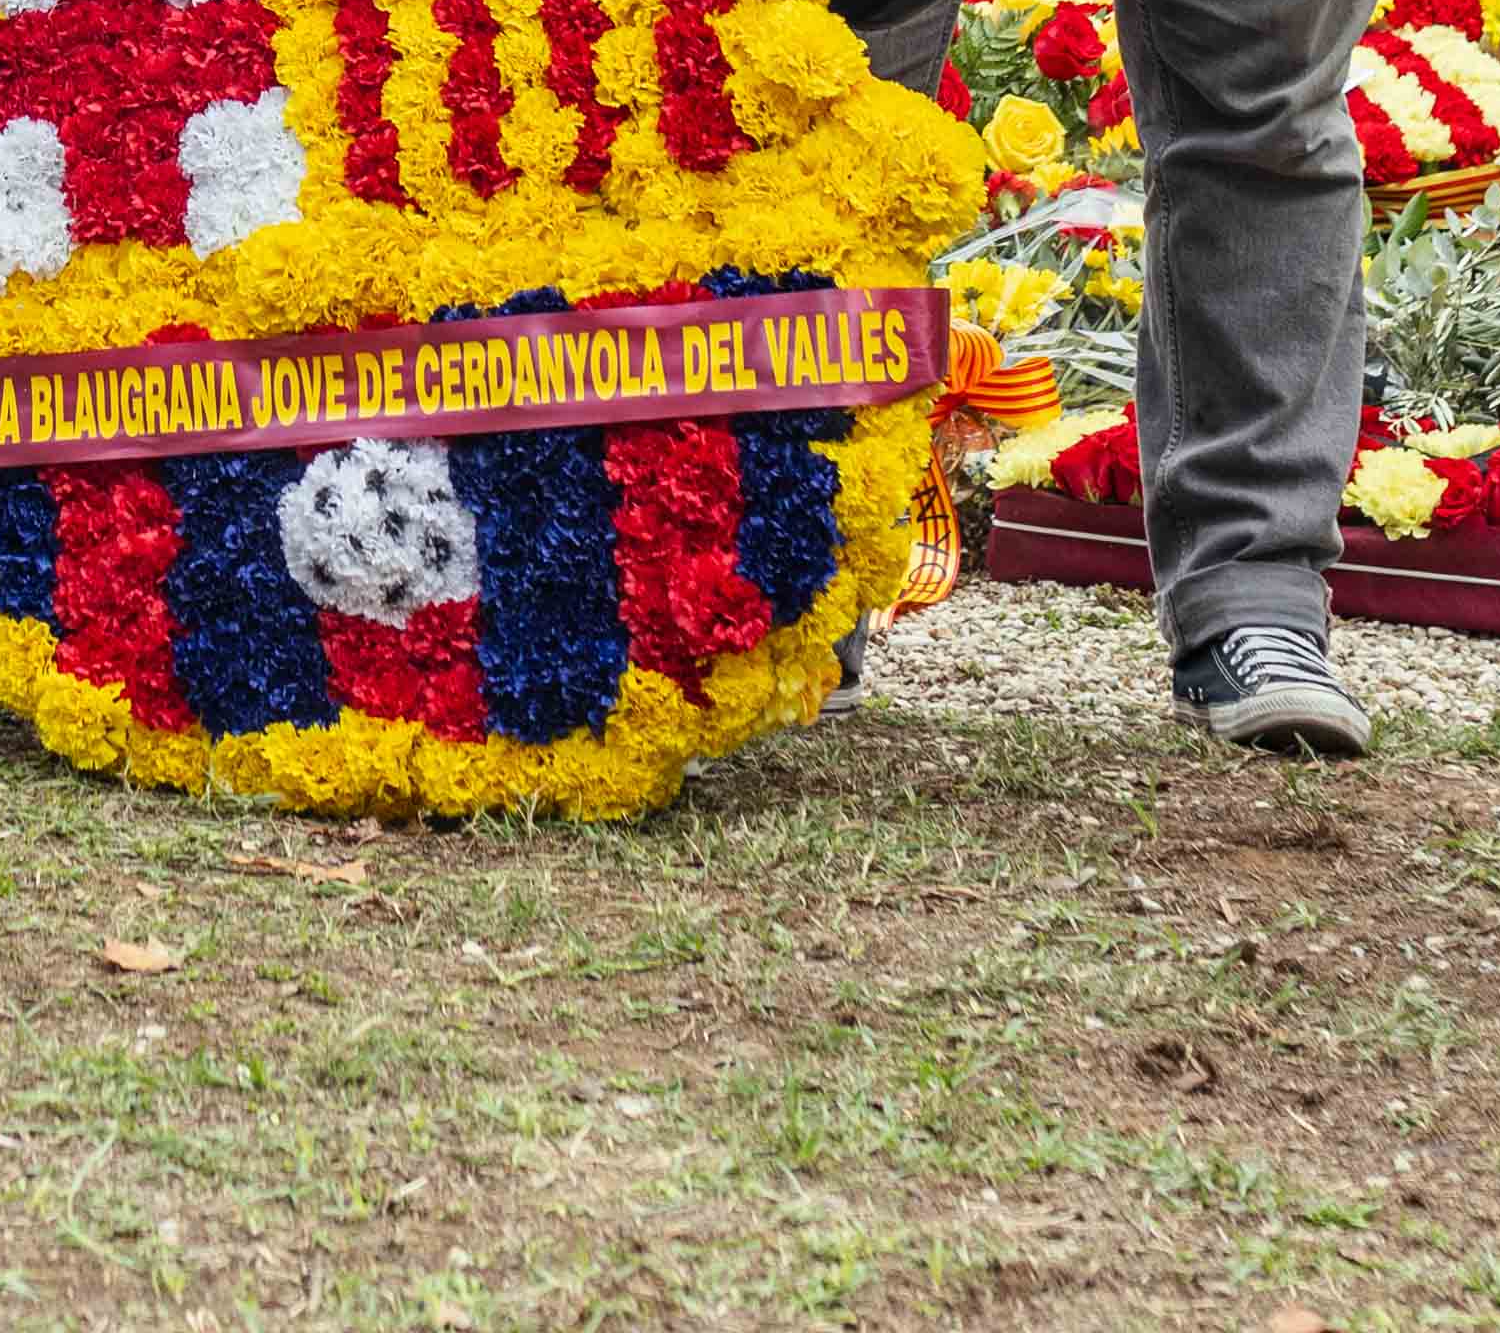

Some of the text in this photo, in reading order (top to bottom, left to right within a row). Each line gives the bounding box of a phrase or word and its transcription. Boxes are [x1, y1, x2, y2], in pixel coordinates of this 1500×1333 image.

[30, 360, 243, 444] BLAUGRANA
[251, 354, 348, 430] JOVE
[355, 348, 406, 420] DE
[414, 326, 668, 415] CERDANYOLA
[682, 320, 757, 395] DEL
[763, 288, 910, 388] VALLÈS
